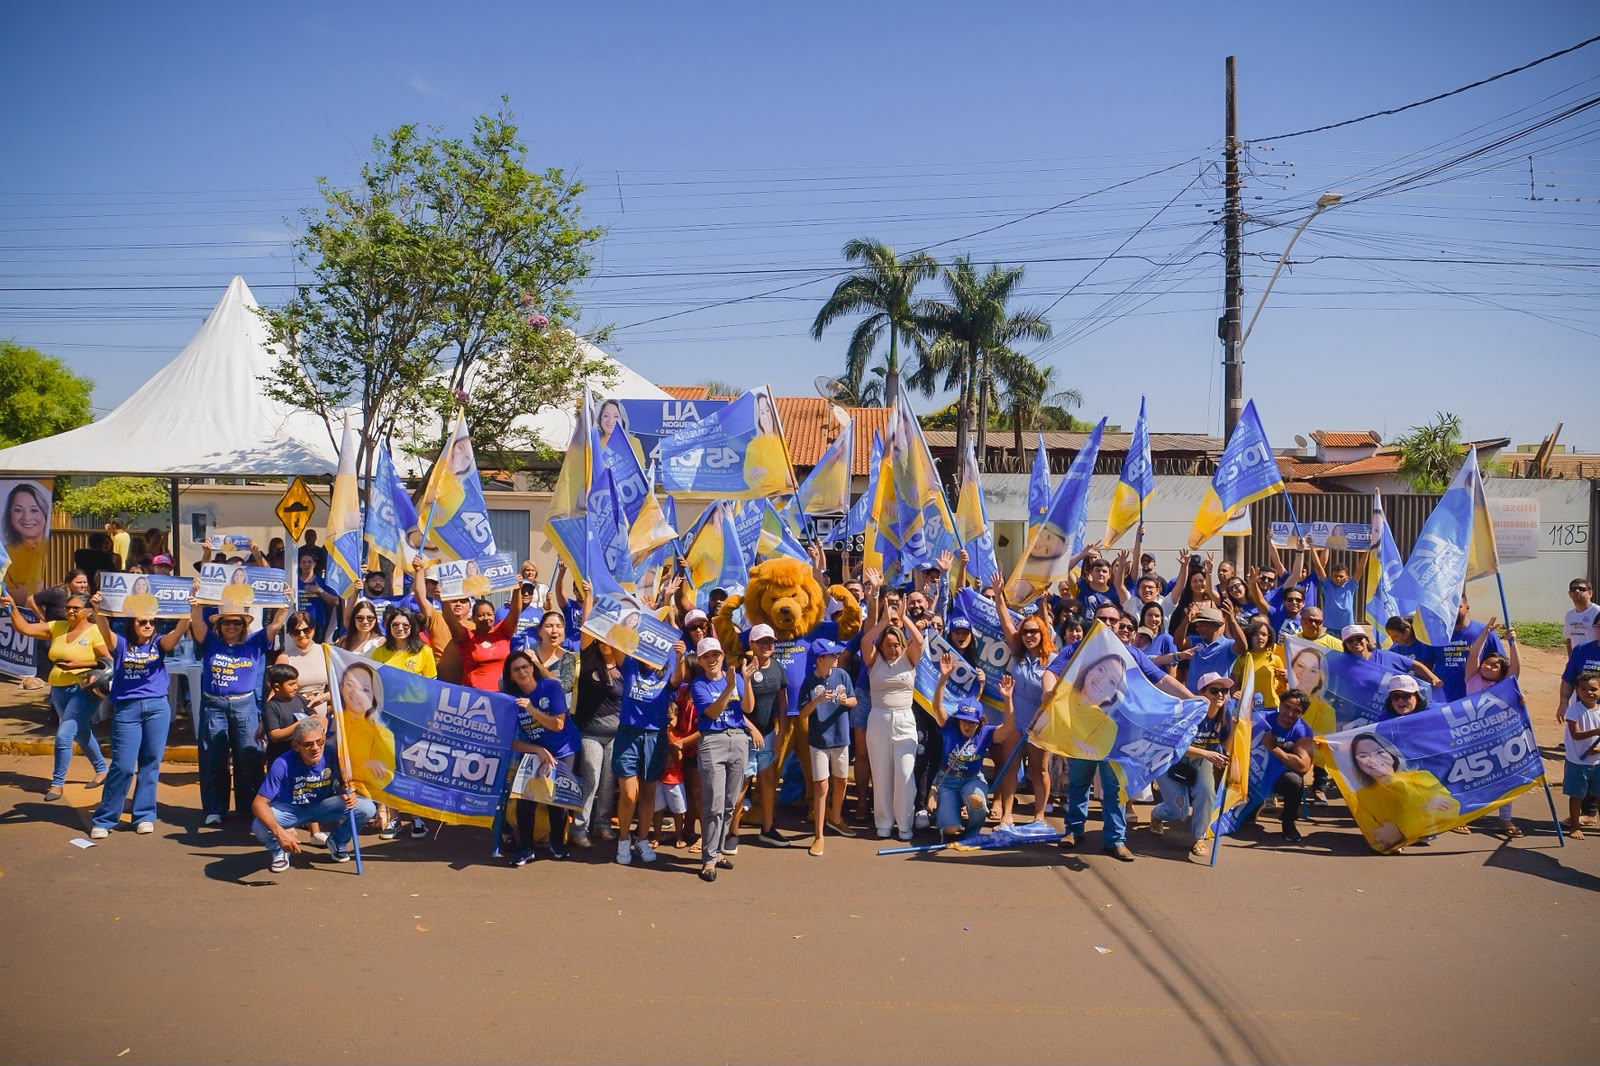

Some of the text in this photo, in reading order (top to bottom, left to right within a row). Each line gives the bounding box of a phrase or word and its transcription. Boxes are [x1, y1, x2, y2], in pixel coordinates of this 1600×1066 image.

[662, 400, 700, 421] LIA
[1215, 441, 1270, 487] 45101
[1273, 524, 1289, 532] LIA
[1312, 524, 1329, 532] LIA
[1549, 524, 1589, 546] 1185
[201, 566, 227, 579] LIA
[438, 563, 462, 577] LIA
[484, 564, 514, 577] 45101
[102, 575, 127, 589] LIA
[251, 580, 284, 592] 45101
[154, 589, 190, 601] 45101
[598, 597, 622, 614] LIA
[639, 630, 673, 652] 45101
[638, 689, 653, 697] COM
[438, 687, 496, 724] LIA
[1441, 691, 1509, 729] LIA
[433, 710, 498, 736] NOGUEIRA
[1449, 707, 1518, 739] NOGUEIRA
[1463, 728, 1495, 743] BICHÃO
[1496, 723, 1508, 732] DO
[421, 732, 460, 748] DEPUTADA
[440, 725, 471, 737] BICHÃO
[471, 732, 483, 740] DO
[483, 735, 496, 743] MS
[401, 740, 500, 786] 45101
[1447, 727, 1537, 784] 45101
[418, 771, 450, 784] BICHÃO
[458, 780, 478, 791] PELO
[480, 785, 492, 793] MS
[1472, 772, 1502, 786] BICHÃO
[1510, 759, 1528, 772] PELO
